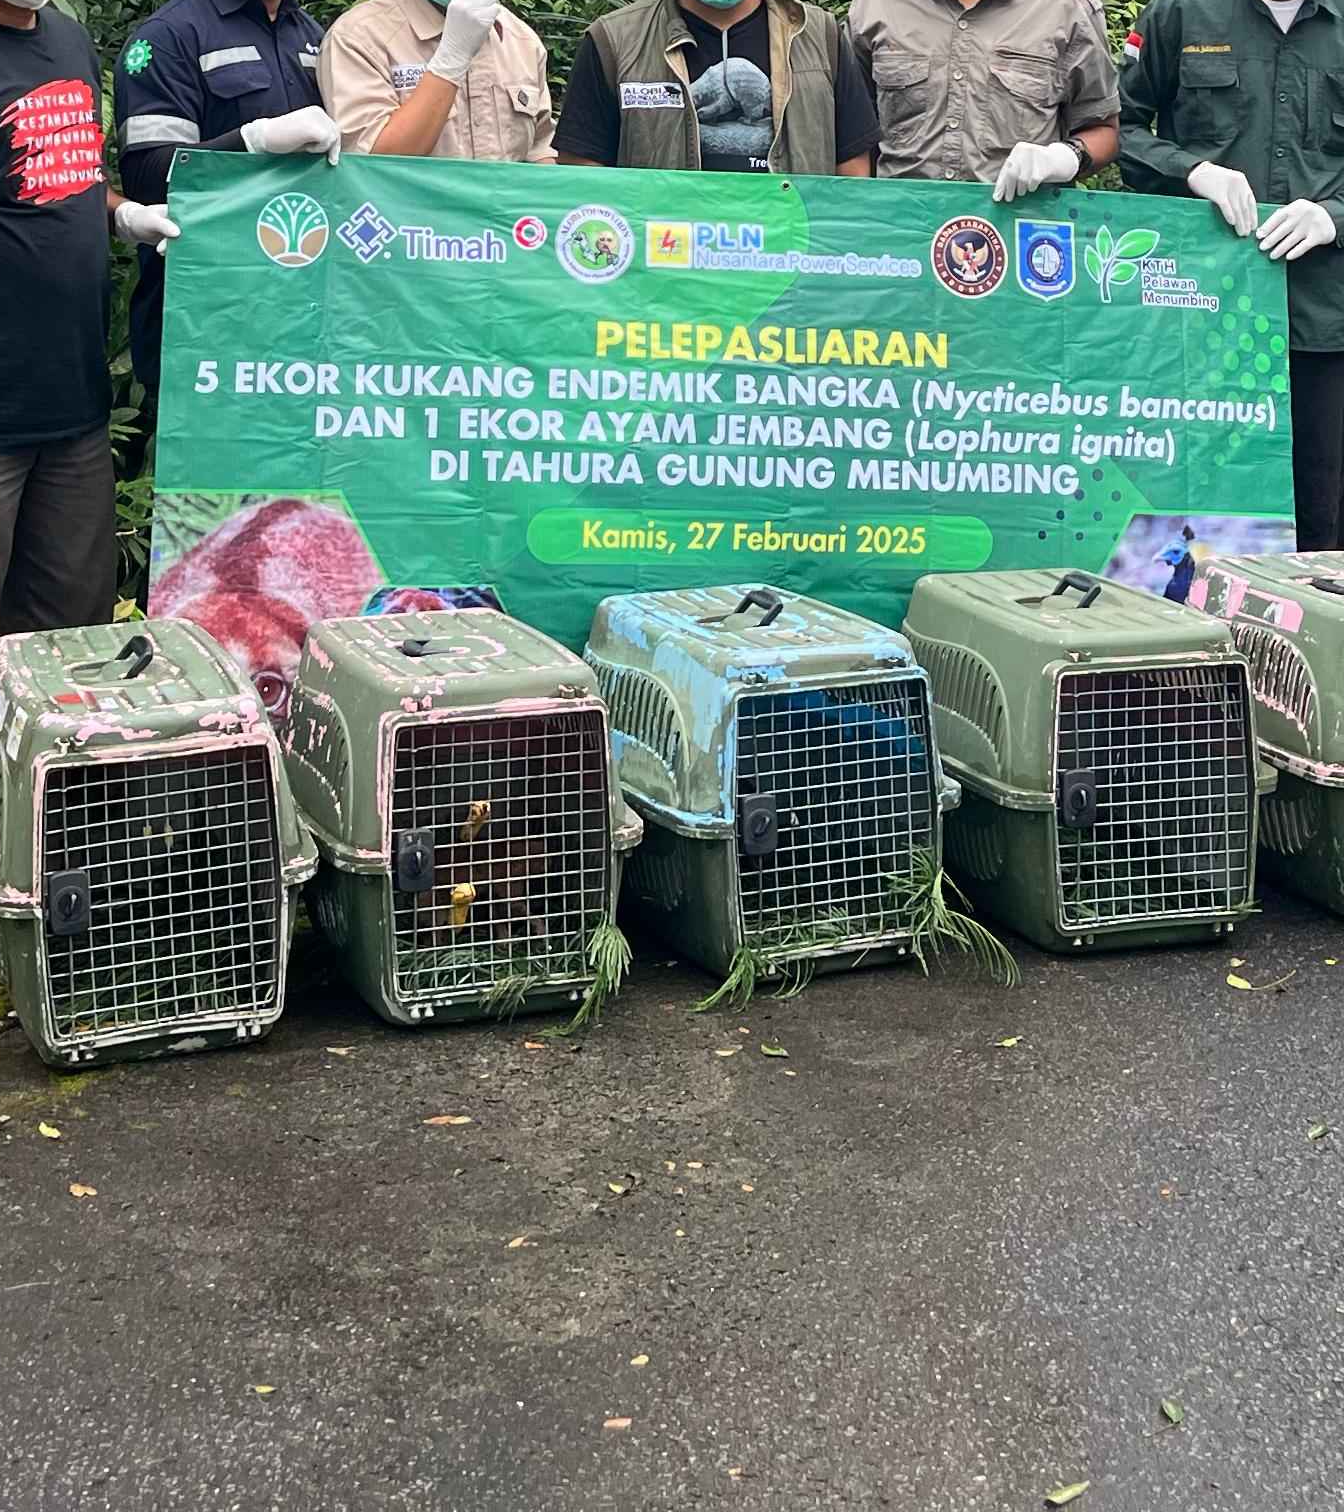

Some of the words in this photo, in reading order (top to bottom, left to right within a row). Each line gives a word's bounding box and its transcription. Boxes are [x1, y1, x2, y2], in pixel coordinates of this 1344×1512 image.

[17, 92, 84, 110] HENTIKAN
[18, 111, 94, 129] KEJAHATAN
[25, 130, 95, 152] TUMBUHAN
[26, 151, 55, 170] DAN
[63, 149, 101, 165] SATWA
[748, 157, 768, 168] Tre
[400, 227, 505, 261] Timah
[696, 224, 762, 249] PLN
[959, 220, 1002, 251] KARANTINA
[696, 250, 786, 269] Nusantara
[789, 252, 843, 273] Power
[844, 253, 920, 276] Services
[1142, 259, 1175, 271] KTH
[936, 263, 1002, 293] INDONESIA
[1143, 275, 1196, 289] Pelawan
[1143, 291, 1217, 309] Menumbing
[596, 320, 949, 369] PELEPASLIARAN
[194, 360, 219, 394] 5
[234, 362, 341, 395] EKOR
[354, 364, 535, 399] KUKANG
[548, 368, 723, 404] ENDEMIK
[735, 374, 900, 409] BANGKA
[912, 378, 1109, 420] (Nycticebus
[1119, 385, 1277, 432] bancanus)
[314, 405, 405, 438] DAN
[424, 407, 439, 439] 1
[458, 407, 567, 441] EKOR
[577, 410, 697, 444] AYAM
[708, 414, 893, 450] JEMBANG
[905, 419, 1061, 461] (Lophura
[1071, 423, 1176, 466] ignita)
[429, 449, 469, 482] DI
[481, 450, 644, 485] TAHURA
[656, 453, 836, 489] GUNUNG
[846, 458, 1080, 496] MENUMBING
[581, 520, 678, 555] Kamis,
[687, 522, 725, 551] 27
[732, 520, 847, 554] Februari
[855, 525, 927, 555] 2025
